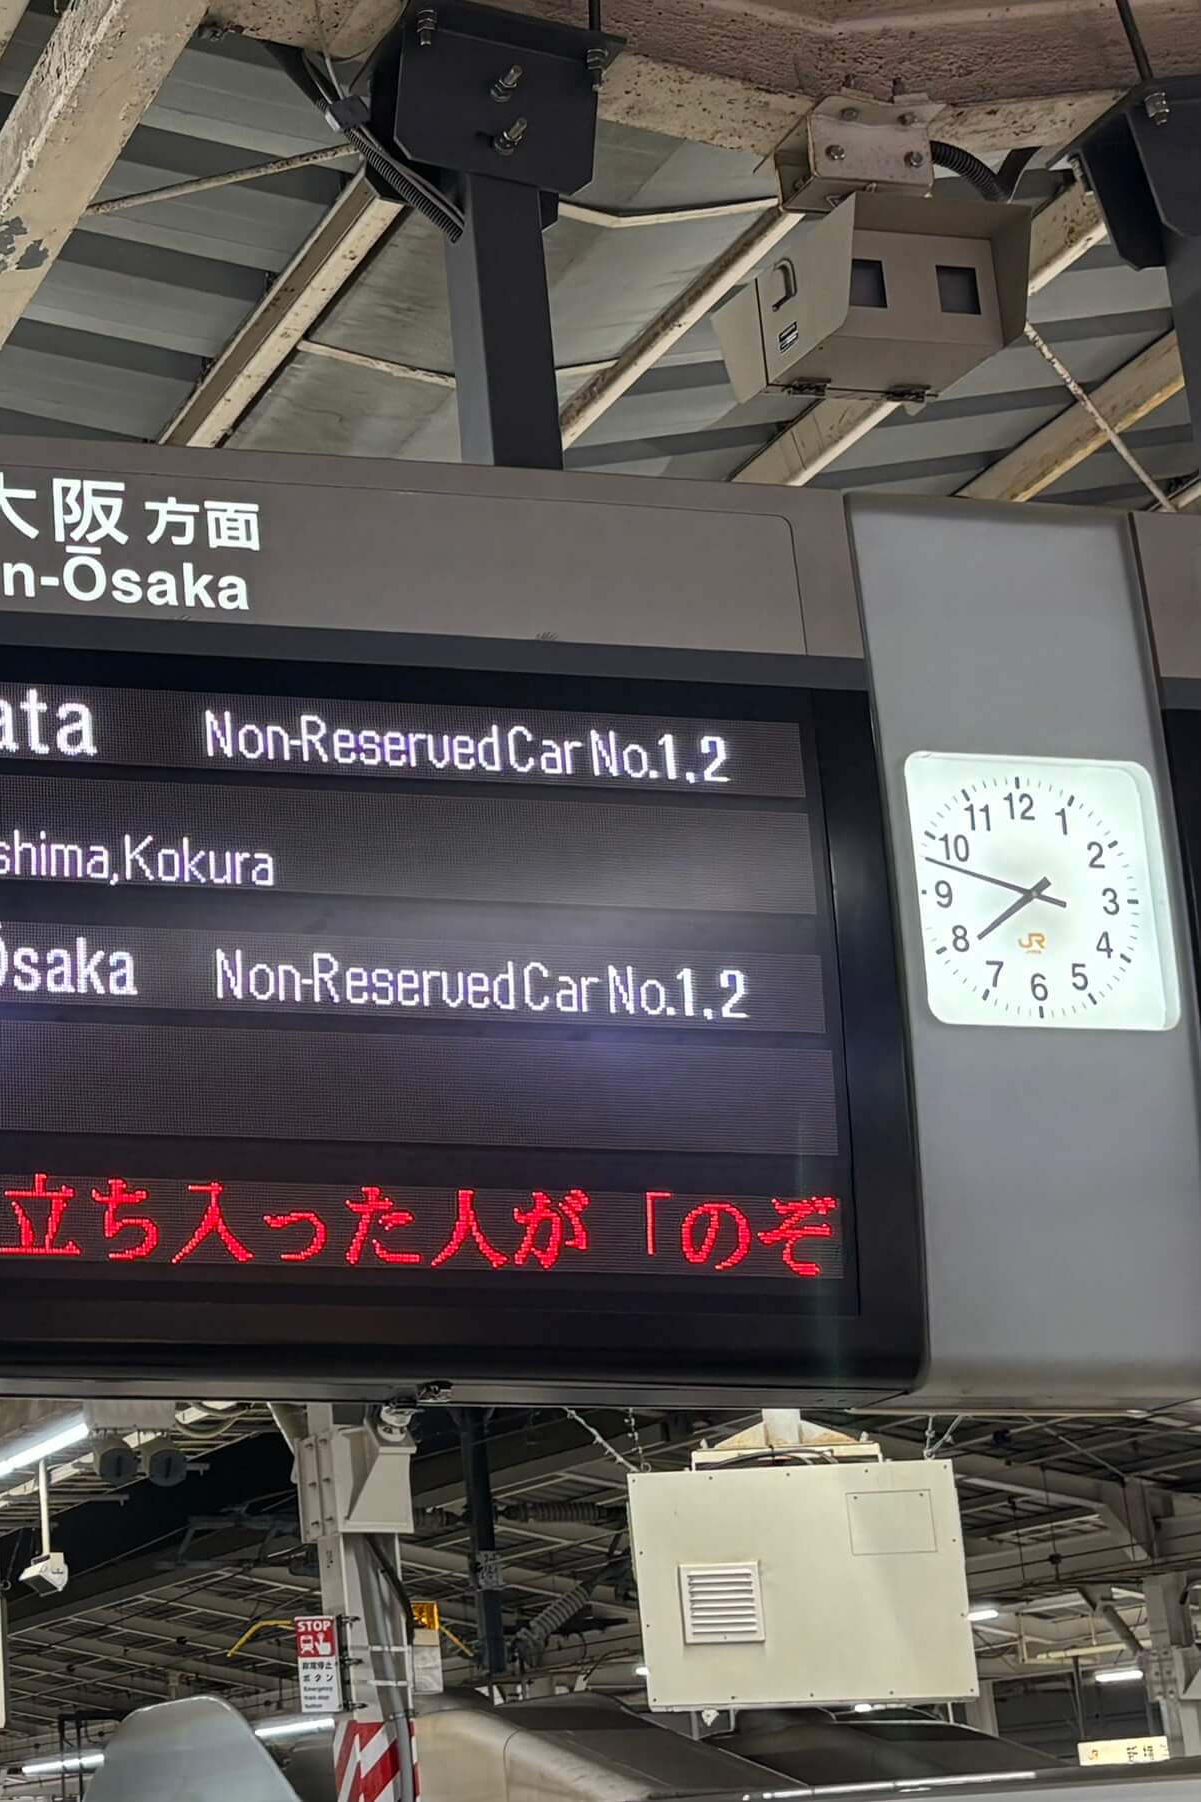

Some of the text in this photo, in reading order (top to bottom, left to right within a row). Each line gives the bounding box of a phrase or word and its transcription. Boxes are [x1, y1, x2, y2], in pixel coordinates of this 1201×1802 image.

[965, 804, 990, 831] 11
[1004, 793, 1035, 820] 12
[1055, 808, 1067, 835] 1
[939, 834, 969, 862] 10
[1088, 842, 1105, 868] 2
[935, 880, 952, 908] 9
[1103, 888, 1119, 915] 3
[952, 925, 969, 952] 8
[1019, 933, 1045, 948] JR
[1097, 932, 1113, 958] 4
[986, 961, 1003, 987] 7
[1031, 973, 1048, 1001] 6
[1072, 964, 1088, 990] 5
[297, 1620, 331, 1632] STOP
